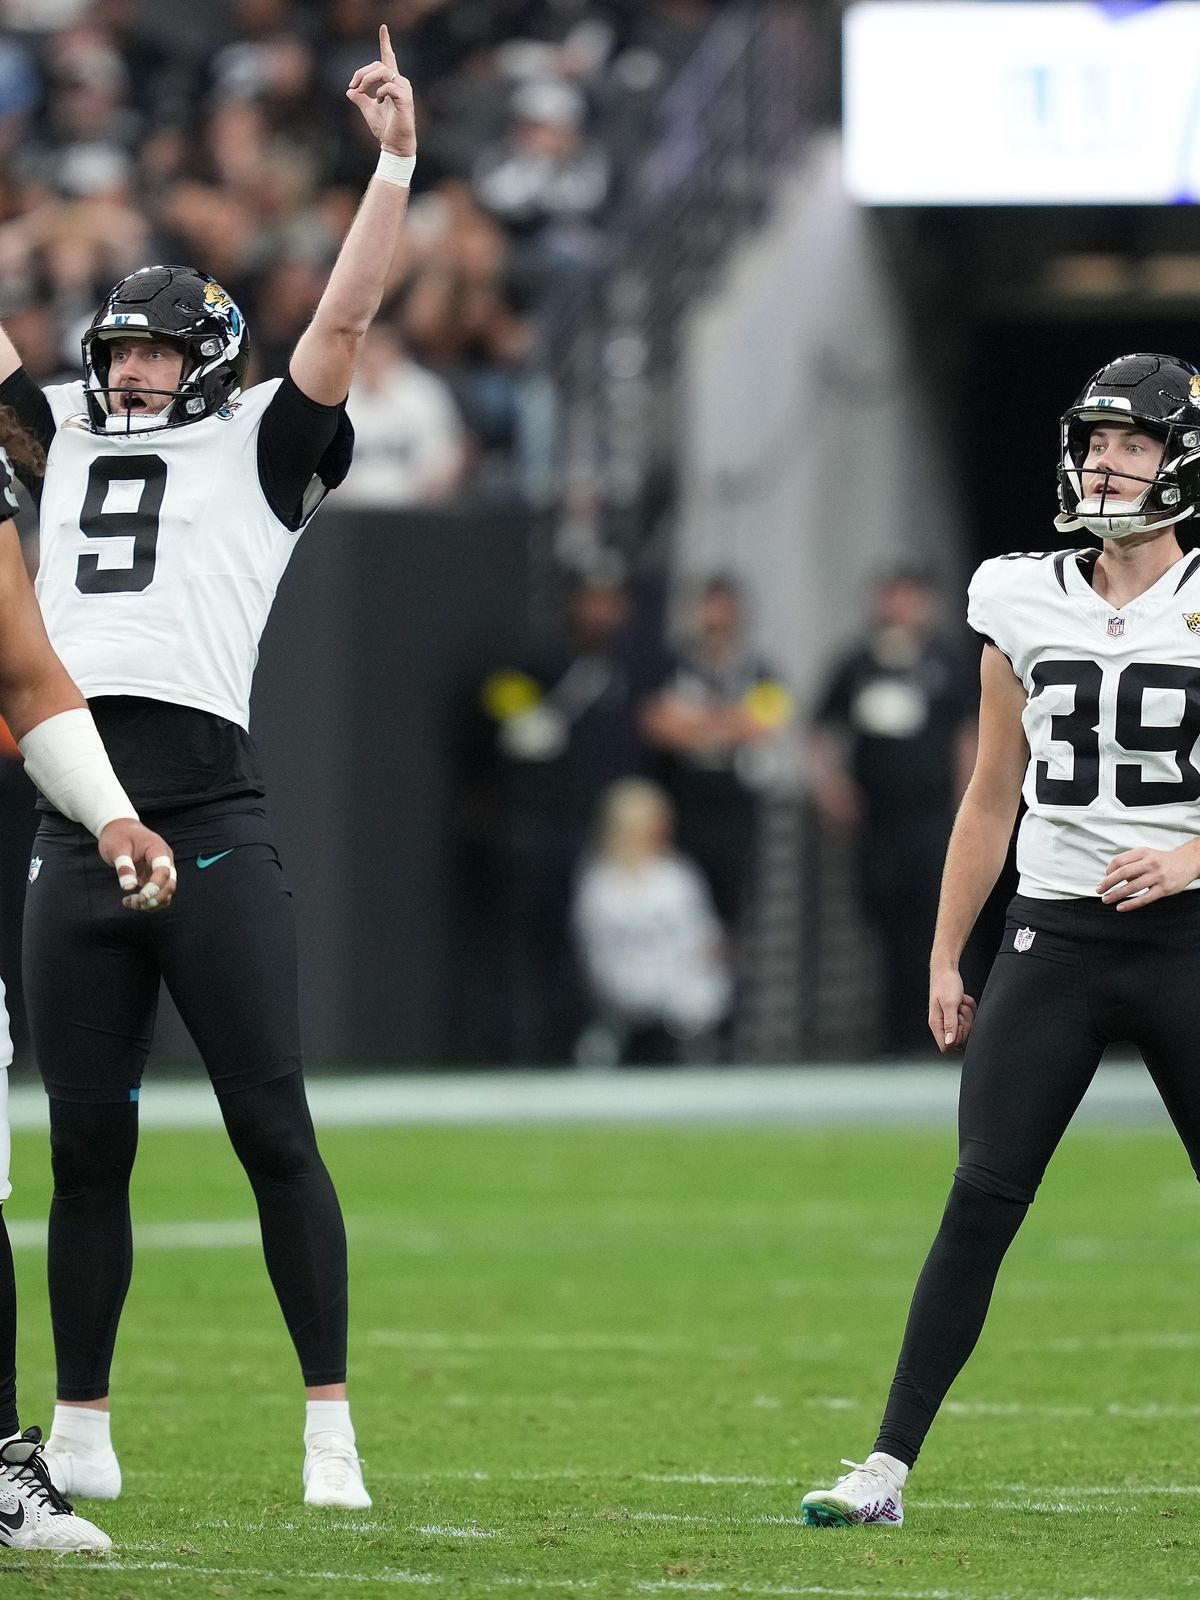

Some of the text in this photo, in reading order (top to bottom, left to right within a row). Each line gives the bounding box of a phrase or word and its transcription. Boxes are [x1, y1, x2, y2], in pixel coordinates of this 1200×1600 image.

[75, 454, 168, 594] 9
[1108, 624, 1122, 635] NFL
[1030, 659, 1200, 808] 39
